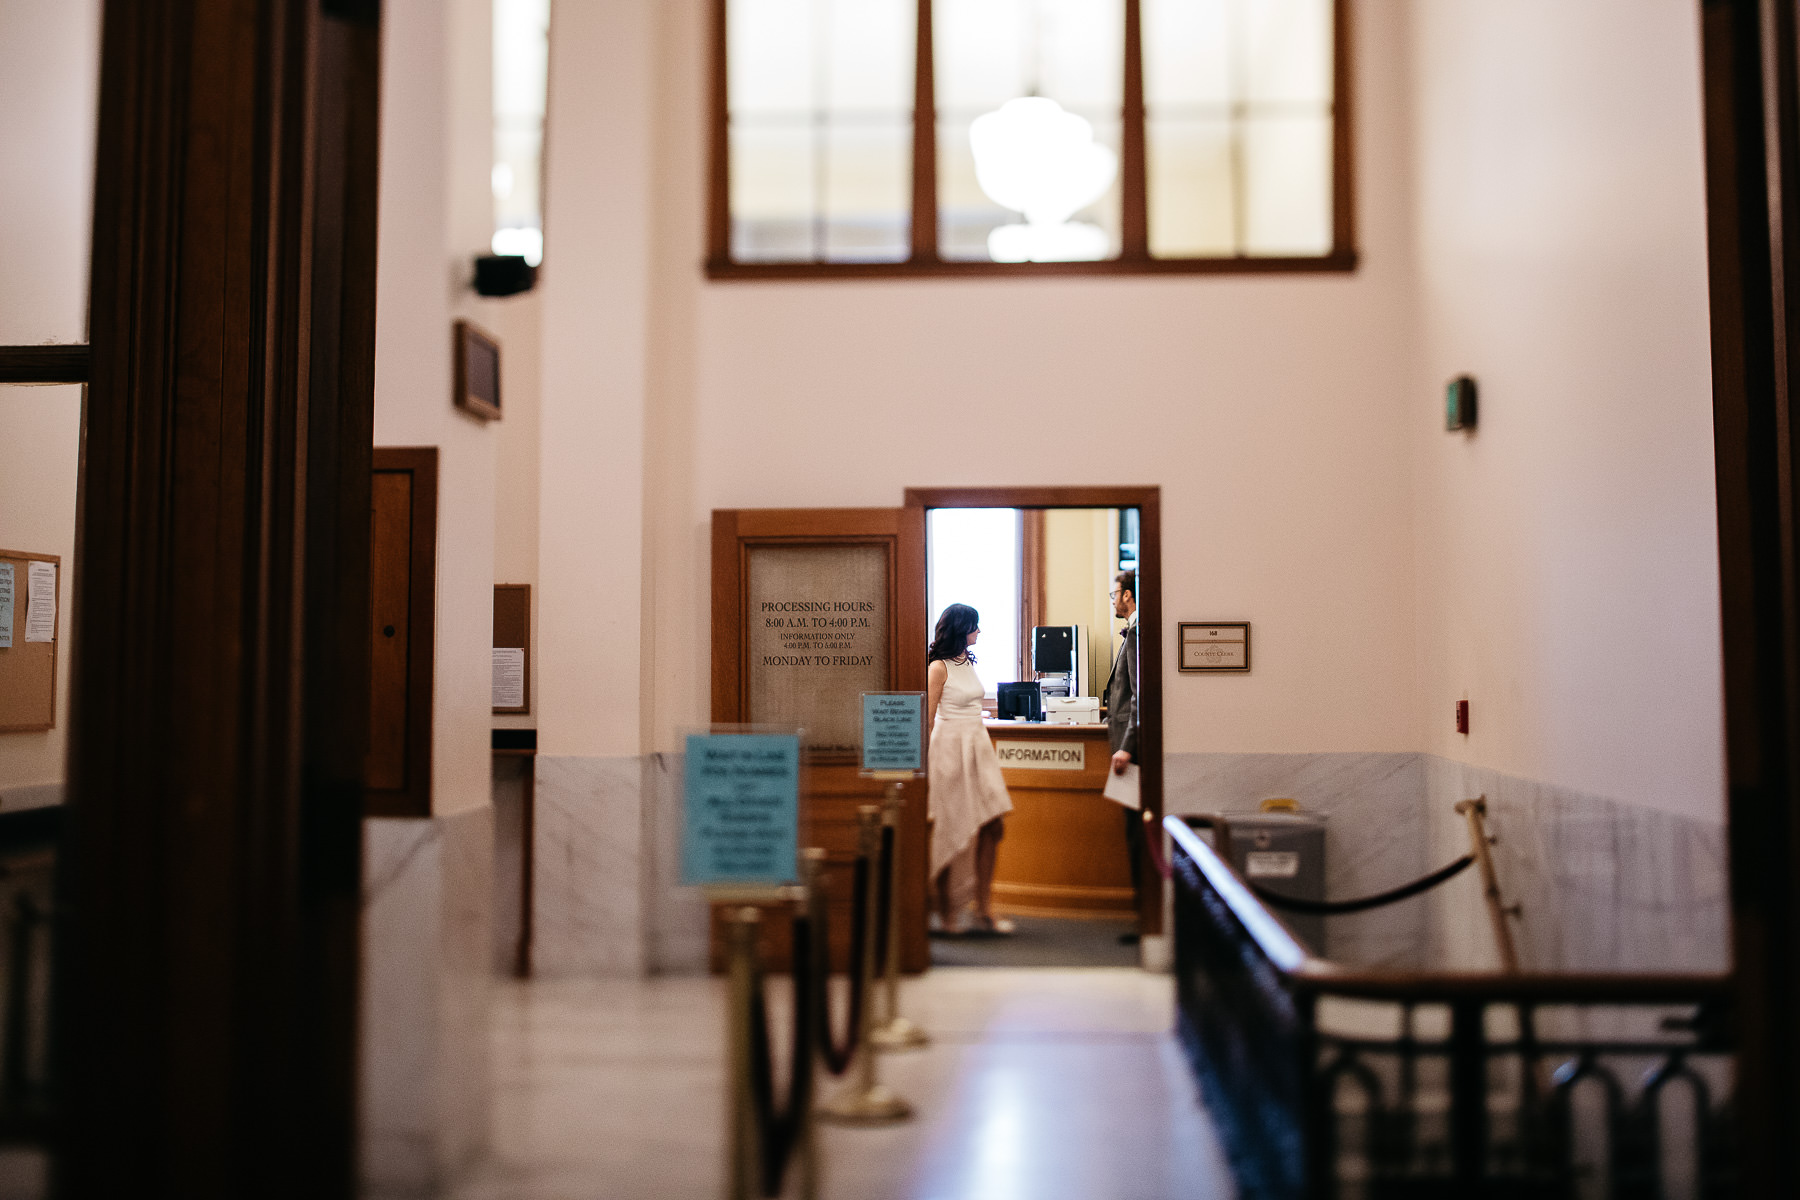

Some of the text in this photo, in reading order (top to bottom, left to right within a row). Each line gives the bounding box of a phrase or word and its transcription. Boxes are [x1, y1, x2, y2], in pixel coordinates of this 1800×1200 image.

[761, 602, 875, 612] PROCESSING HOURS:
[765, 618, 871, 628] 8:00 A.M. TO 4:00 P.M.
[762, 656, 873, 666] MONDAY TO FRIDAY
